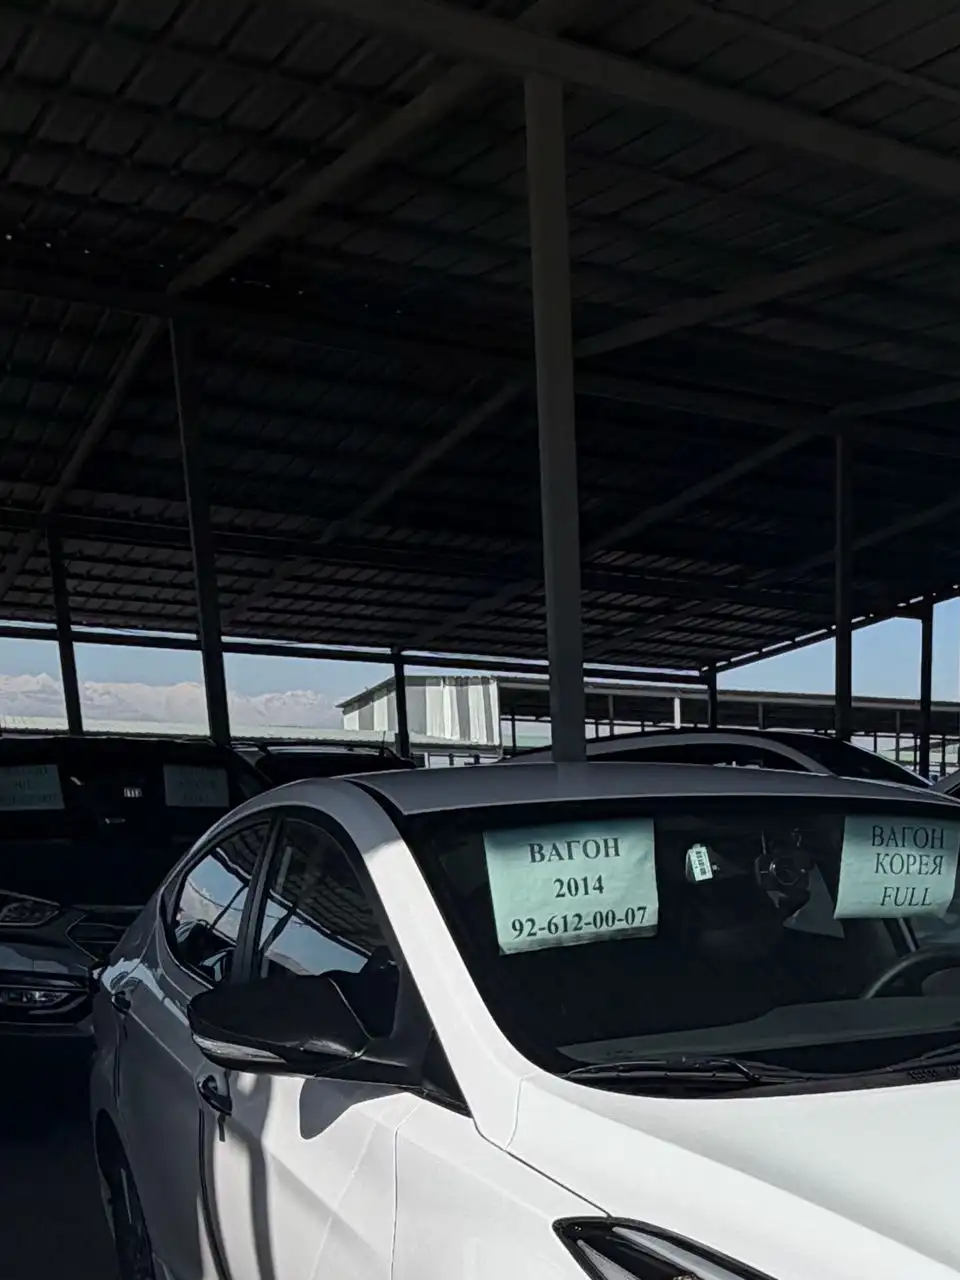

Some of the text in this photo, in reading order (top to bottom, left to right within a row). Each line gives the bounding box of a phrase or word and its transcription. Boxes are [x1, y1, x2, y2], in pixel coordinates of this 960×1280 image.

[871, 825, 945, 849] ВАГОН
[528, 837, 621, 864] ВАГОН
[874, 853, 943, 876] КОРЕЯ
[554, 875, 604, 899] 2014
[880, 887, 933, 907] FULL
[511, 906, 647, 939] 92-612-00-07
